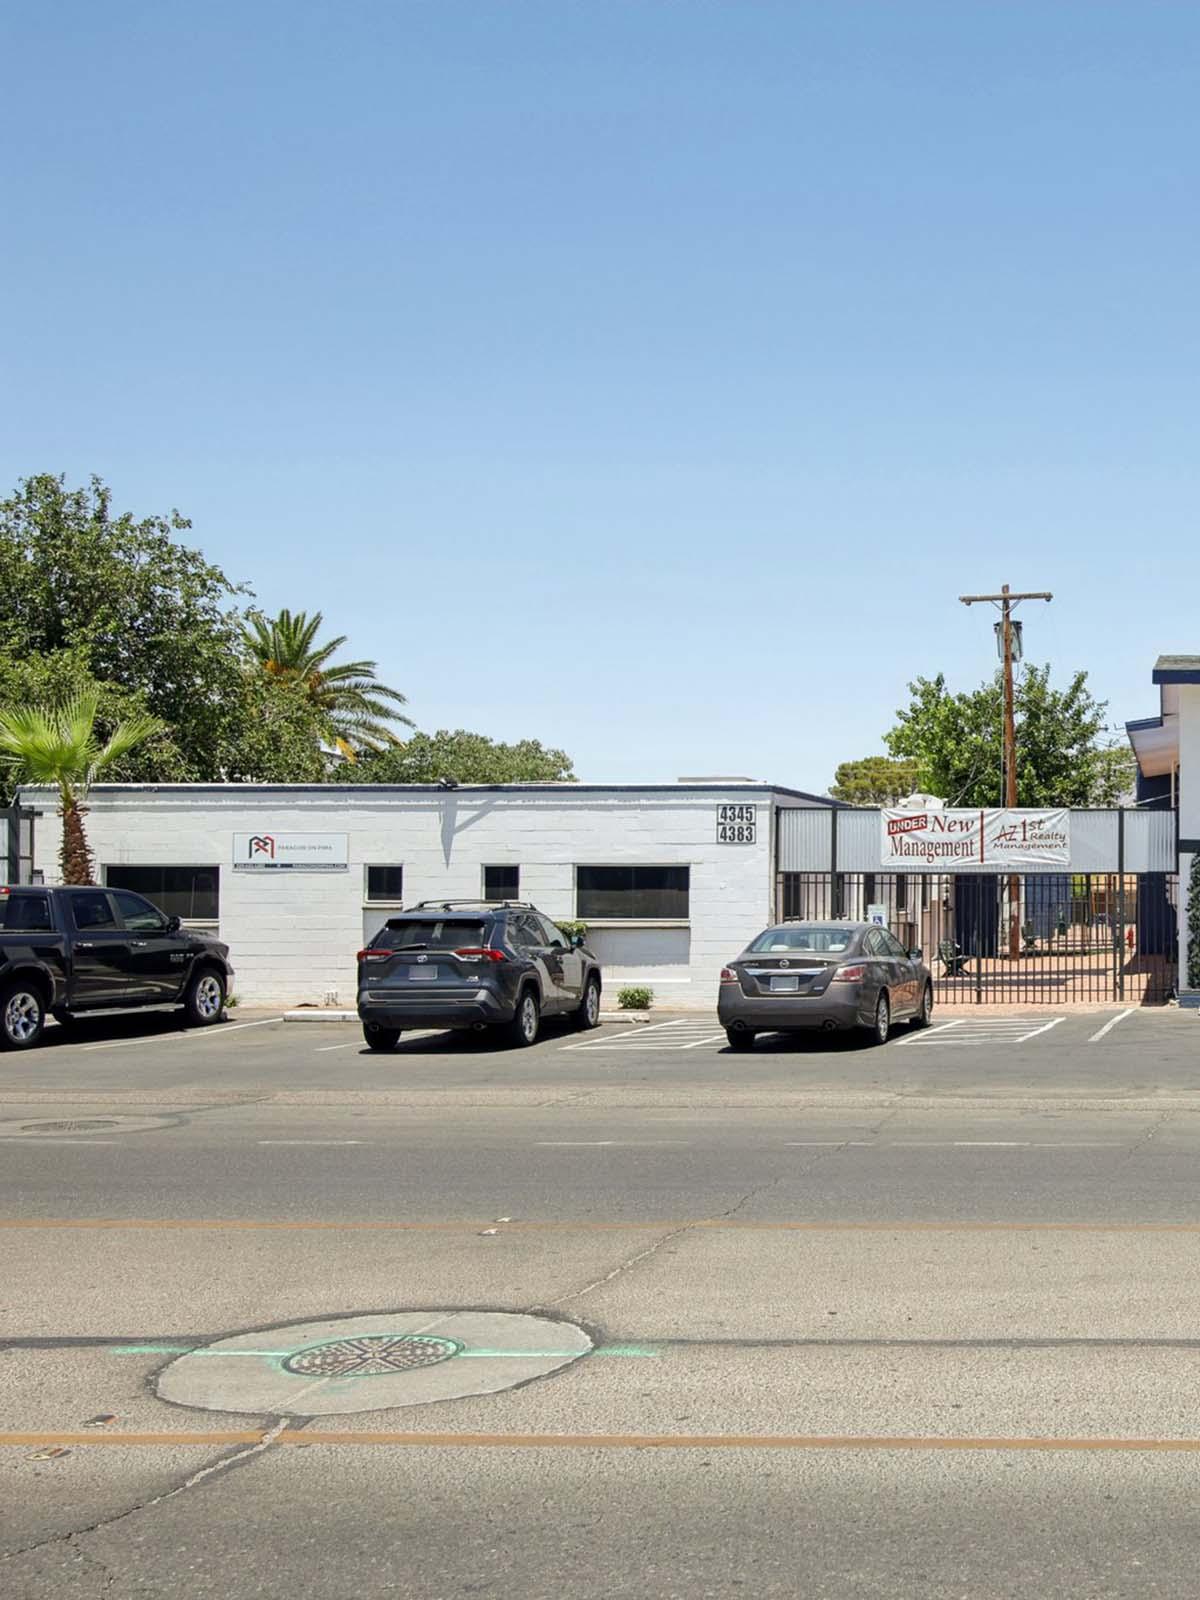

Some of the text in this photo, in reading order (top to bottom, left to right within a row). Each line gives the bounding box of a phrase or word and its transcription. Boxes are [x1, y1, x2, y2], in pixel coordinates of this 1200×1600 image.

[720, 806, 753, 821] 4345
[888, 815, 975, 833] UNDER New
[720, 826, 753, 841] 4383
[1030, 831, 1067, 843] Realty
[890, 836, 975, 863] Management
[993, 841, 1068, 851] Management
